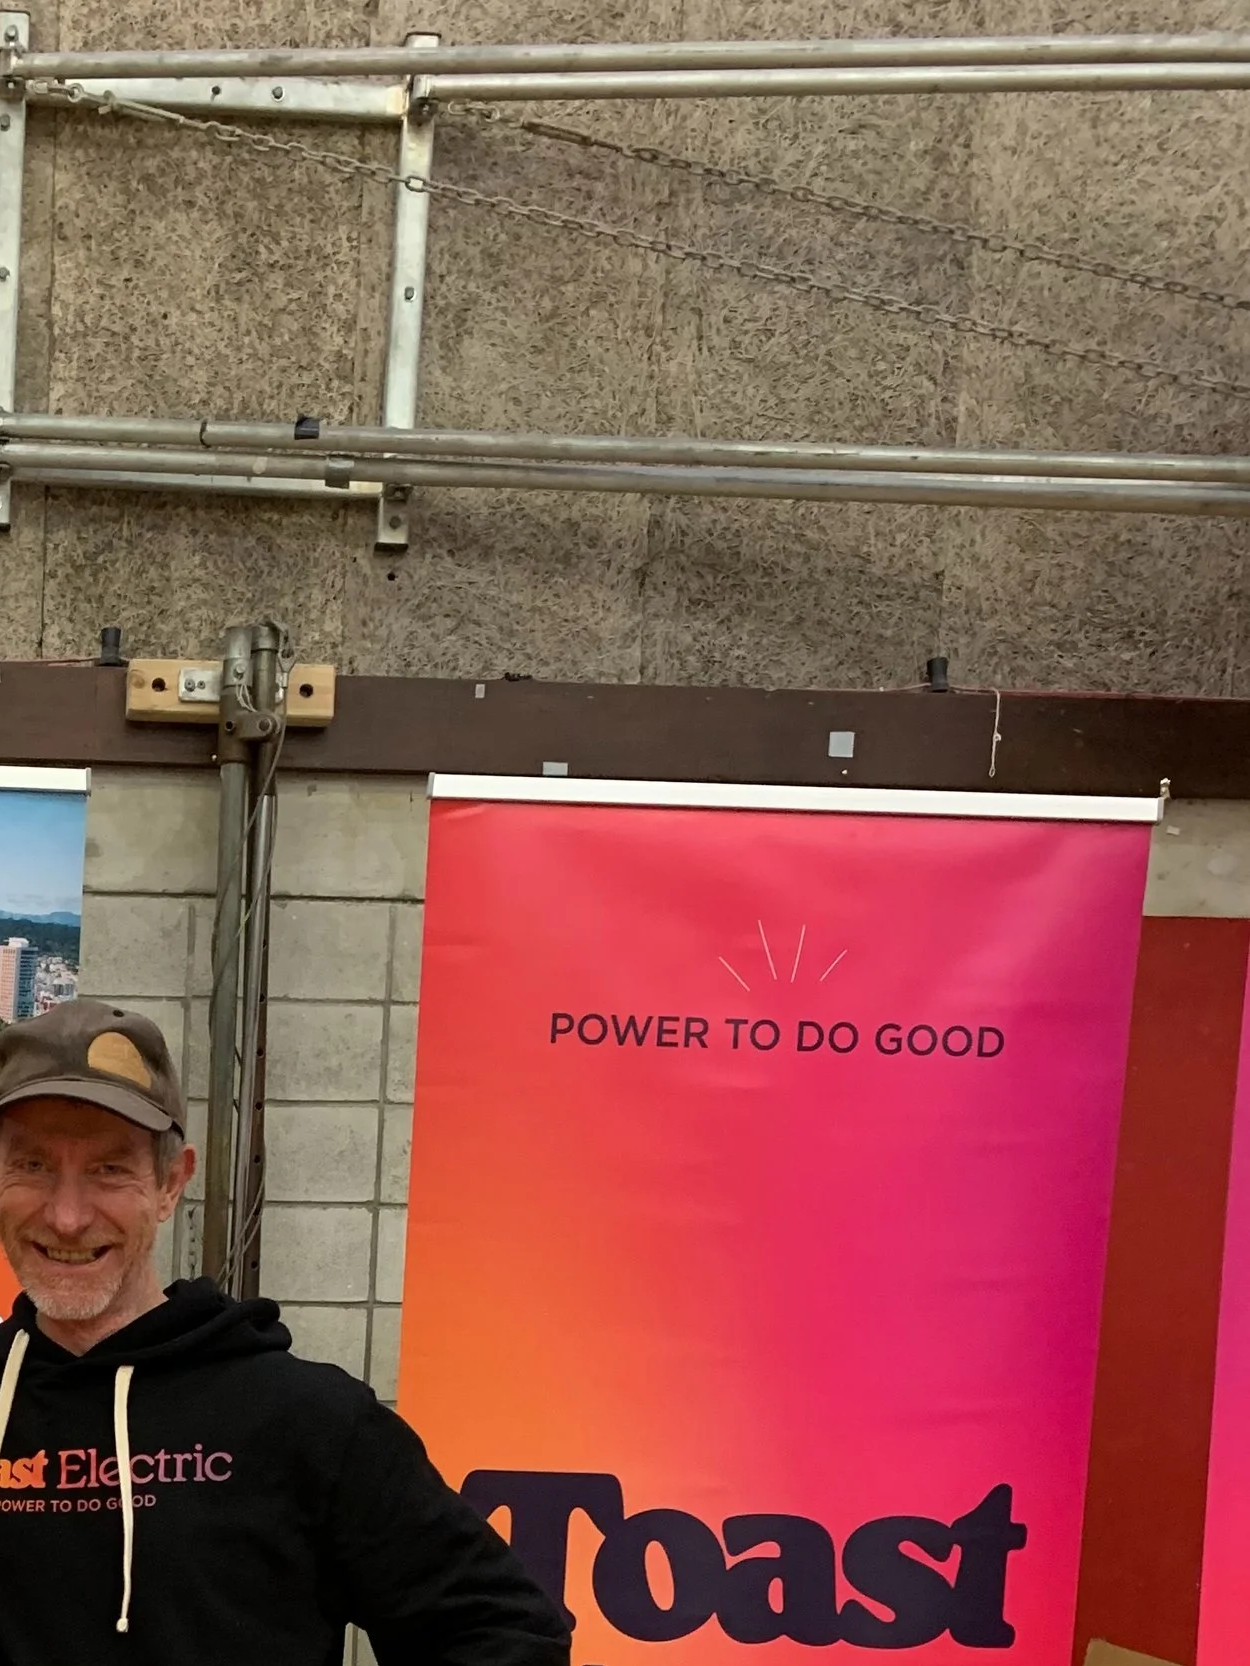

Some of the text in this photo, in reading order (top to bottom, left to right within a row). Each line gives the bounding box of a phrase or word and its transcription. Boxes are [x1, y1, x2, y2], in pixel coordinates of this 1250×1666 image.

[550, 1012, 1005, 1058] POWER TO DO GOOD
[57, 1443, 233, 1489] Electric
[51, 1500, 72, 1513] TO
[77, 1498, 101, 1511] DO
[106, 1494, 157, 1510] GOD
[461, 1470, 1027, 1649] Toast
